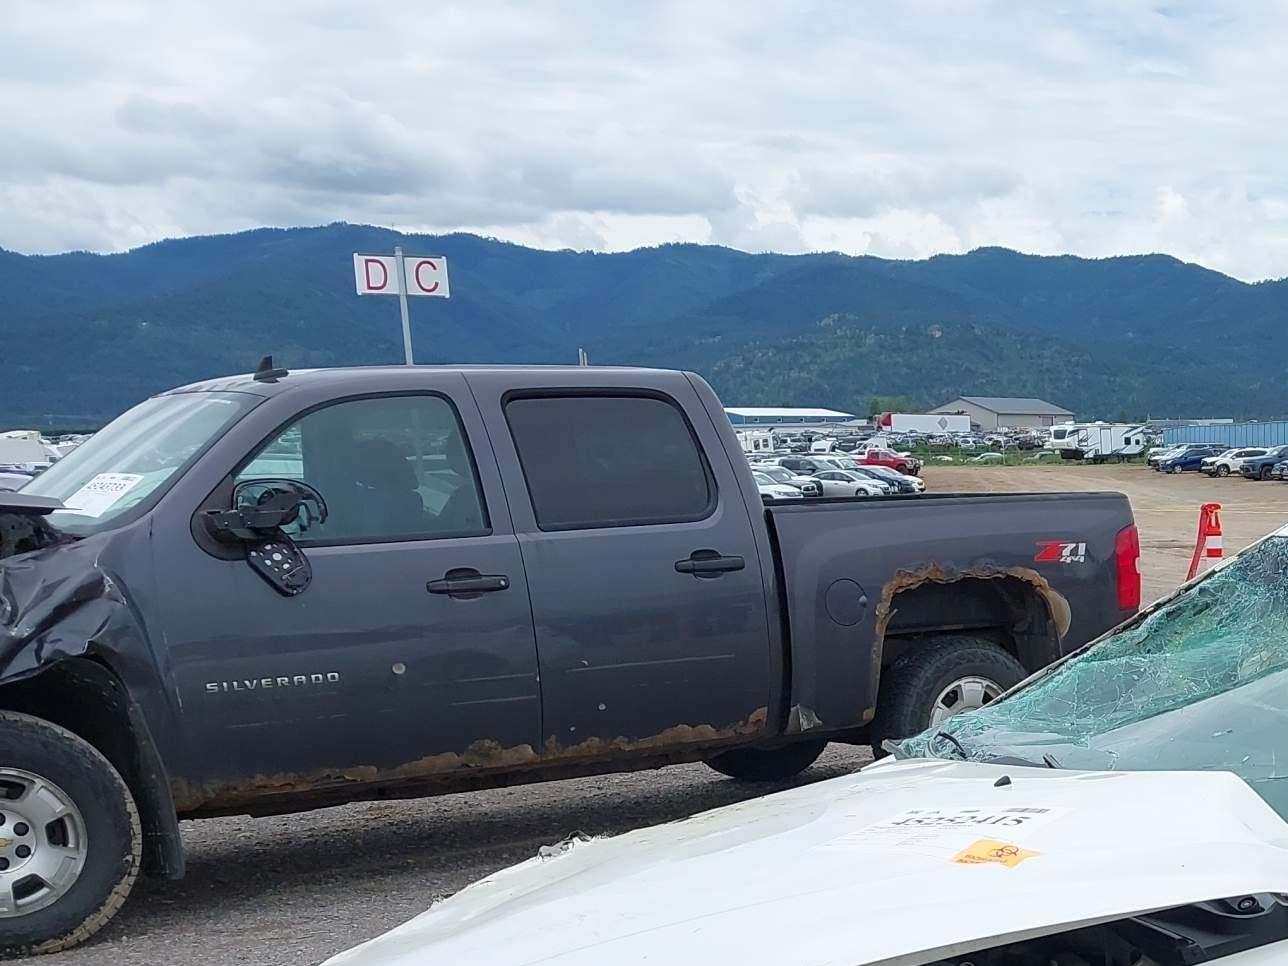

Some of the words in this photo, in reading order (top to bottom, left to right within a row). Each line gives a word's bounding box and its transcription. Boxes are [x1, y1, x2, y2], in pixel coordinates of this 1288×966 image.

[364, 258, 388, 290] D
[415, 260, 439, 293] C
[1034, 540, 1087, 562] Z71
[205, 672, 340, 693] SILVERADO
